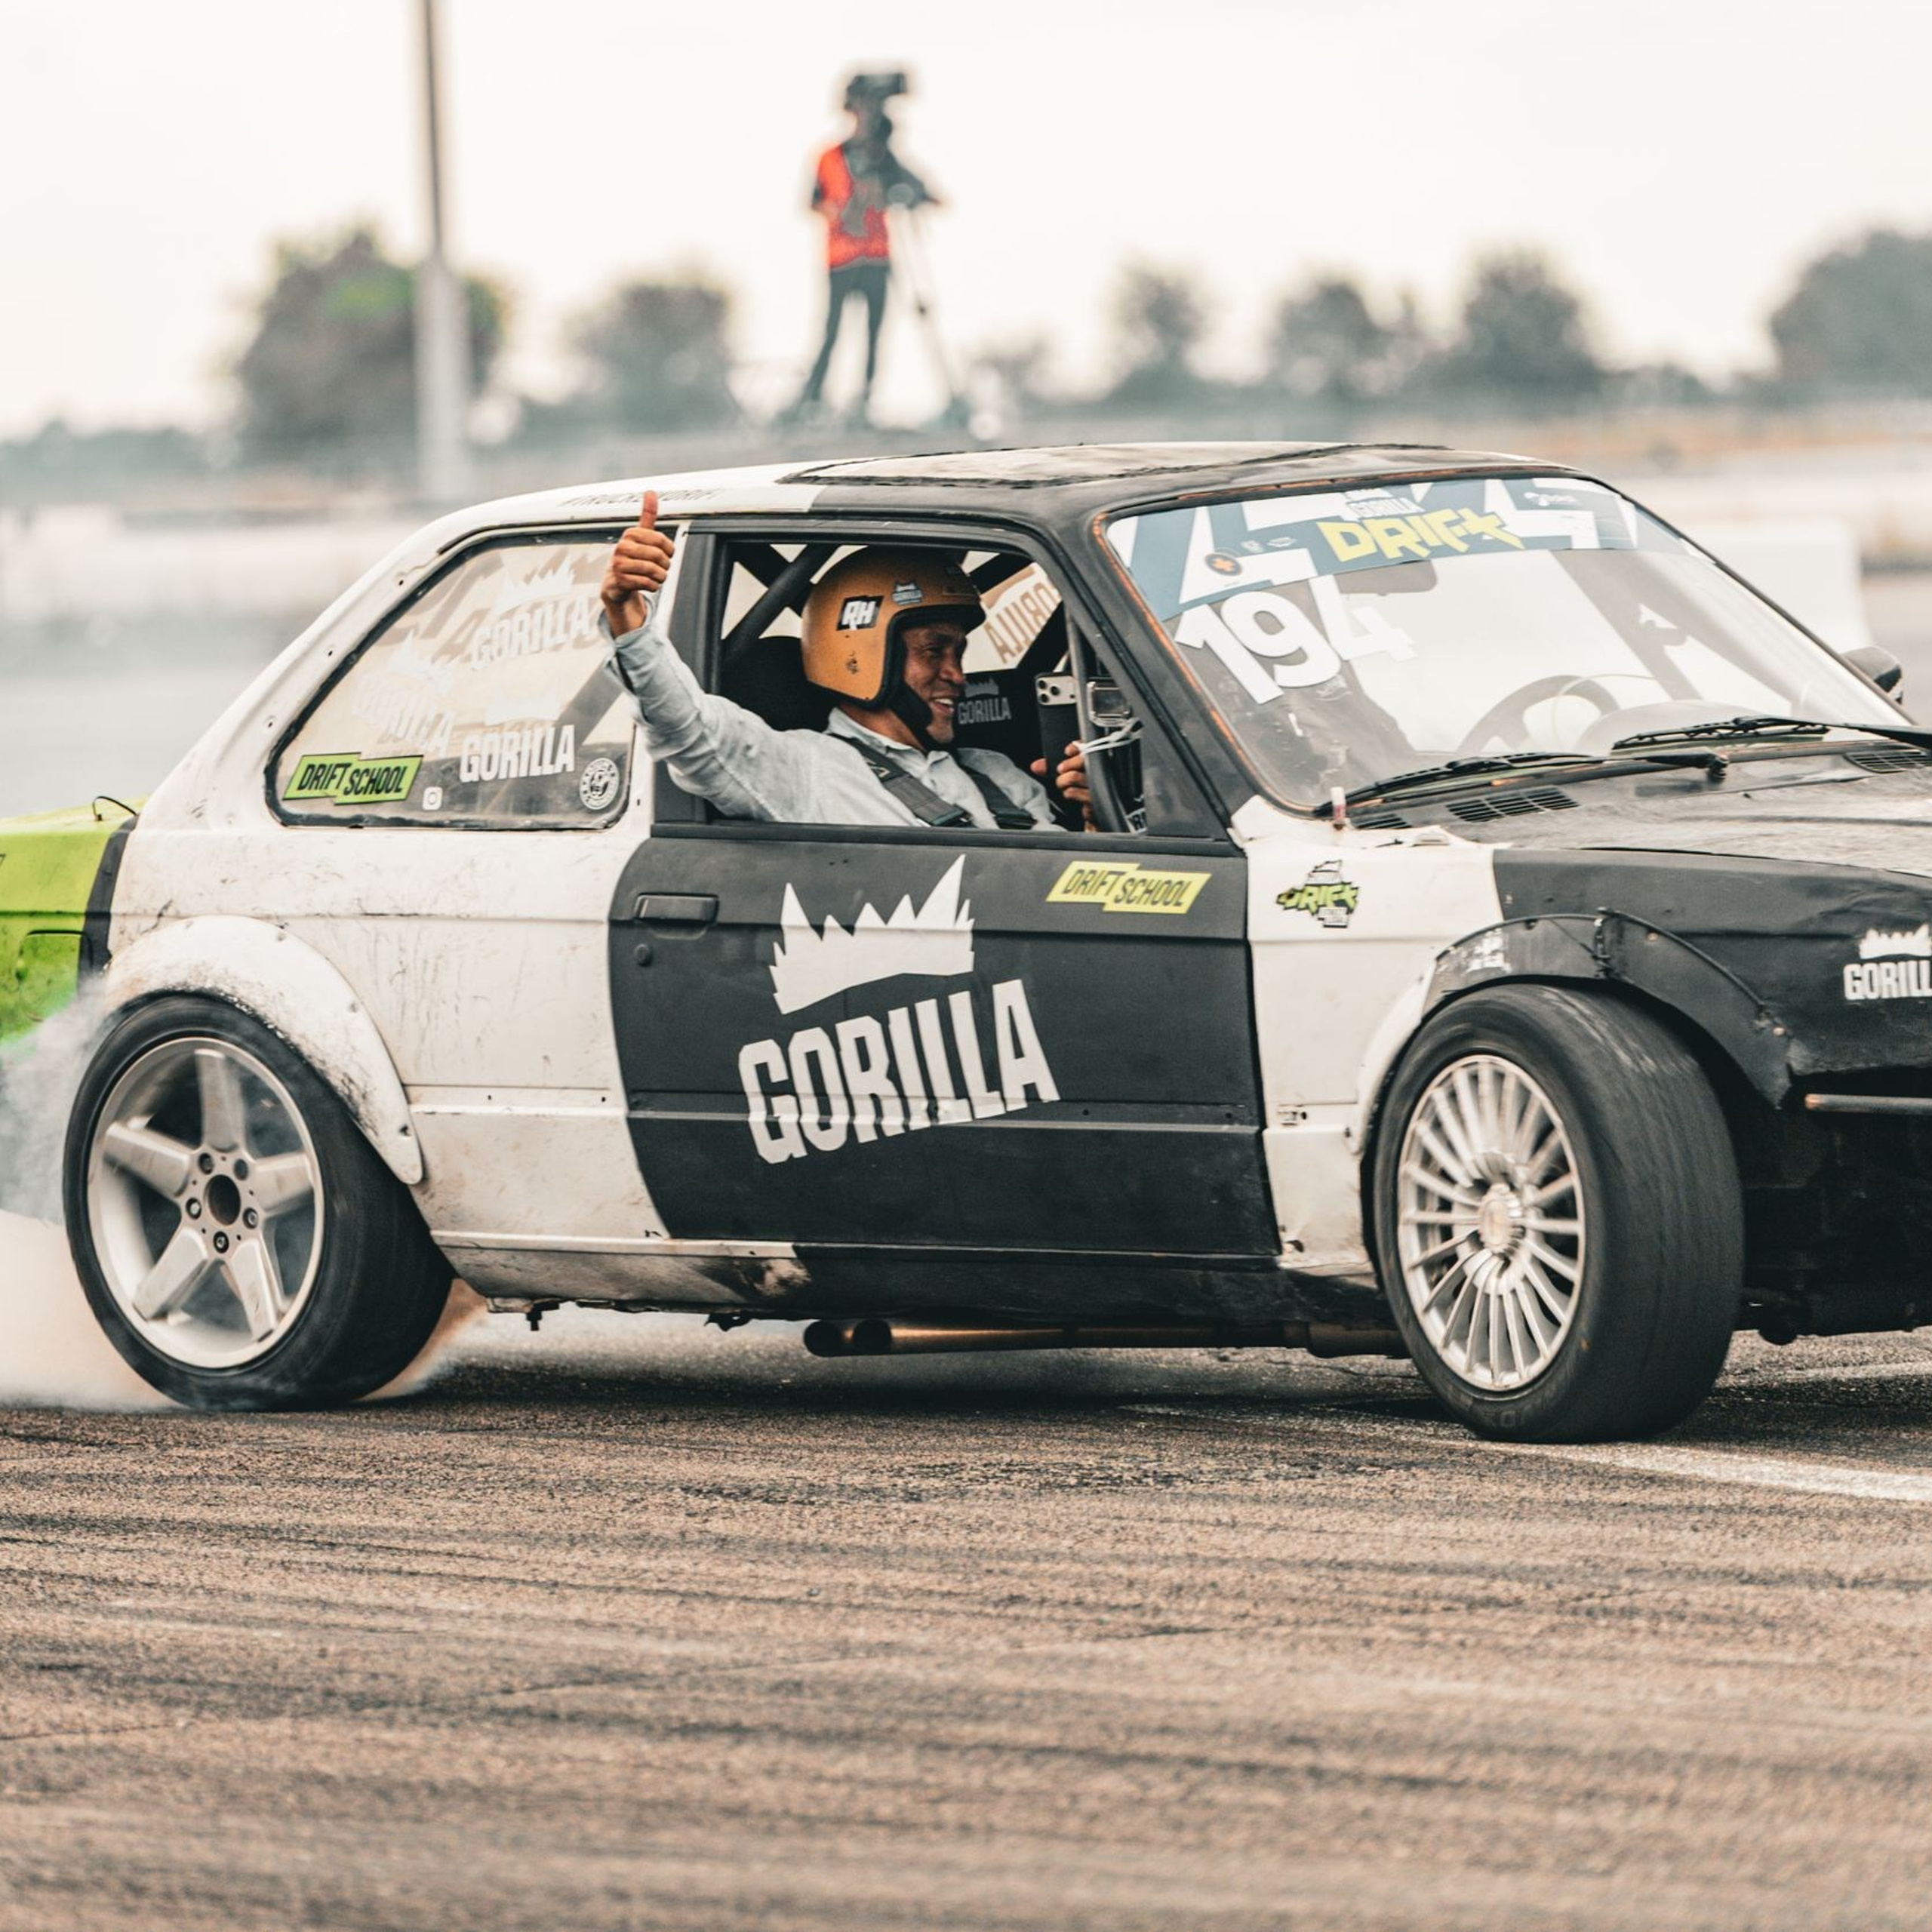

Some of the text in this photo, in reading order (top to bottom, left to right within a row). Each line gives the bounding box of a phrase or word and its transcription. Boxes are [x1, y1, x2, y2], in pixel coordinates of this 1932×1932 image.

[1315, 507, 1526, 561] DRIFT
[470, 593, 592, 670] GORILLA
[1174, 574, 1419, 703] 194
[957, 697, 1012, 726] GORILLA
[297, 762, 408, 796] DRIFT SCHOOL
[459, 724, 575, 783] GORILLA
[1062, 869, 1193, 907] DRIFT SCHOOL
[738, 979, 1060, 1164] GORILLA
